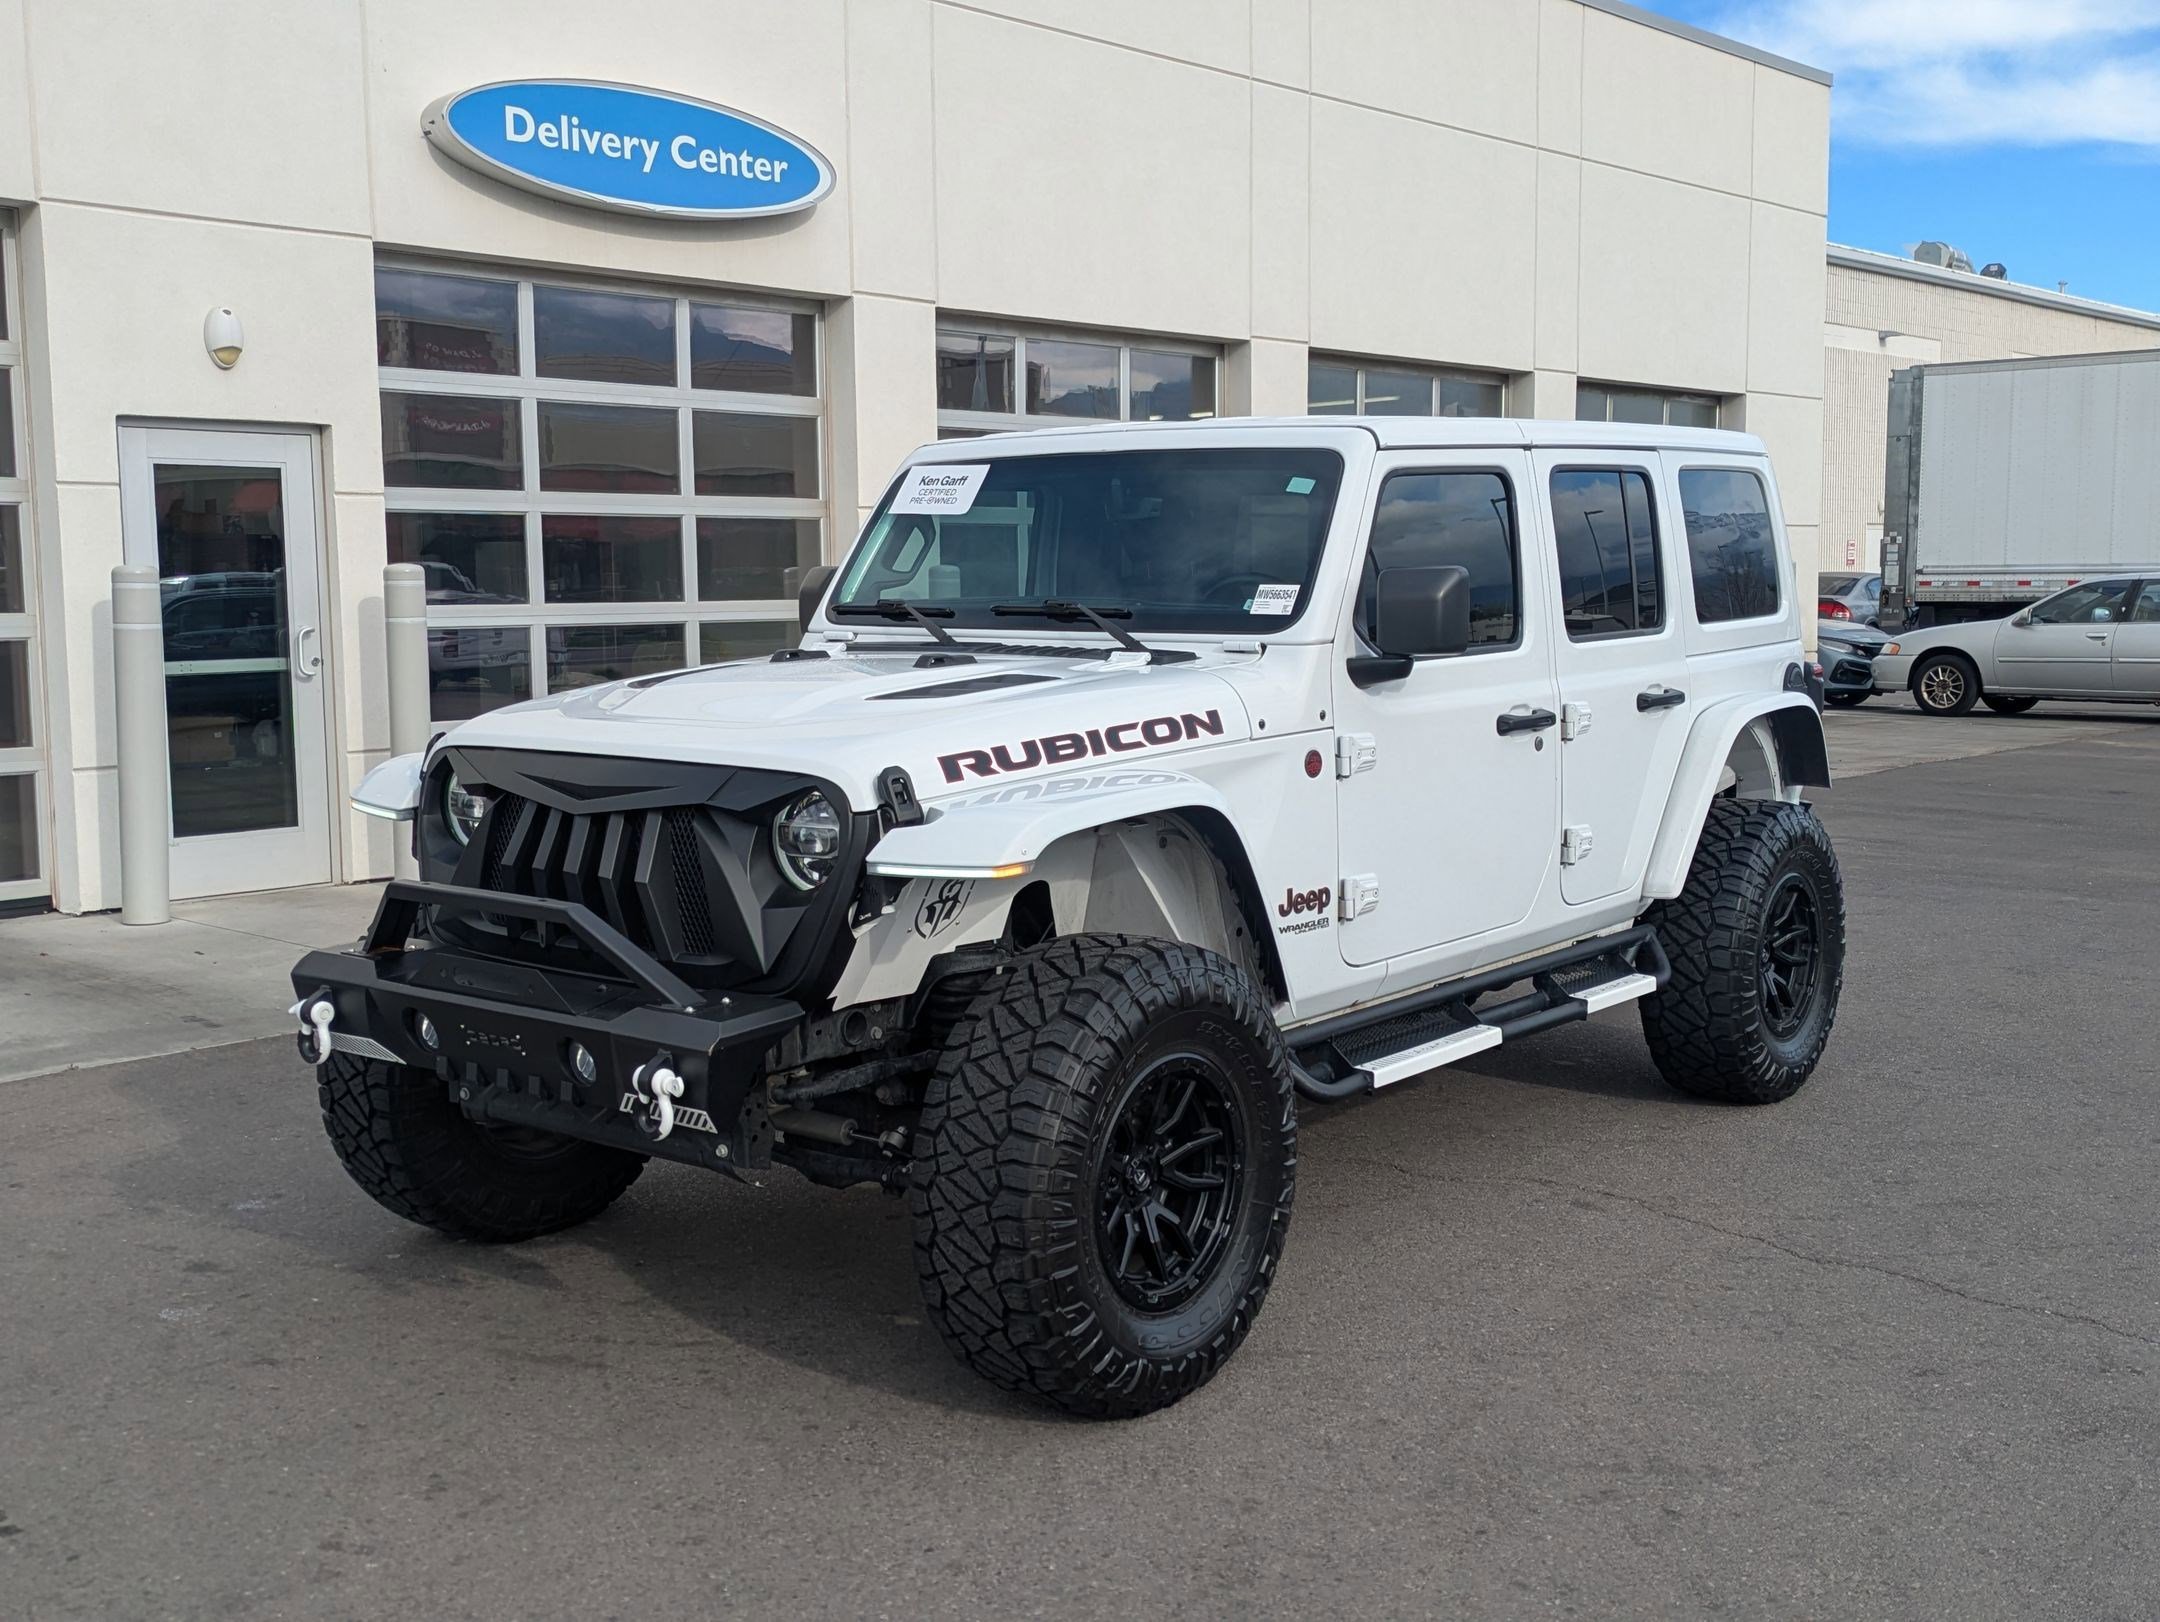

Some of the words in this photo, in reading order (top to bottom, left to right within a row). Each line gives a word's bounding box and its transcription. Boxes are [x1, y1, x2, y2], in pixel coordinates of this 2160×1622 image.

[505, 105, 660, 173] Delivery
[671, 135, 788, 183] Center
[918, 488, 957, 496] CERTIFIED
[919, 475, 940, 486] Ken
[941, 475, 969, 486] Garff
[937, 709, 1225, 784] RUBICON
[1278, 886, 1331, 917] Jeep
[1278, 917, 1330, 935] WRANGLER
